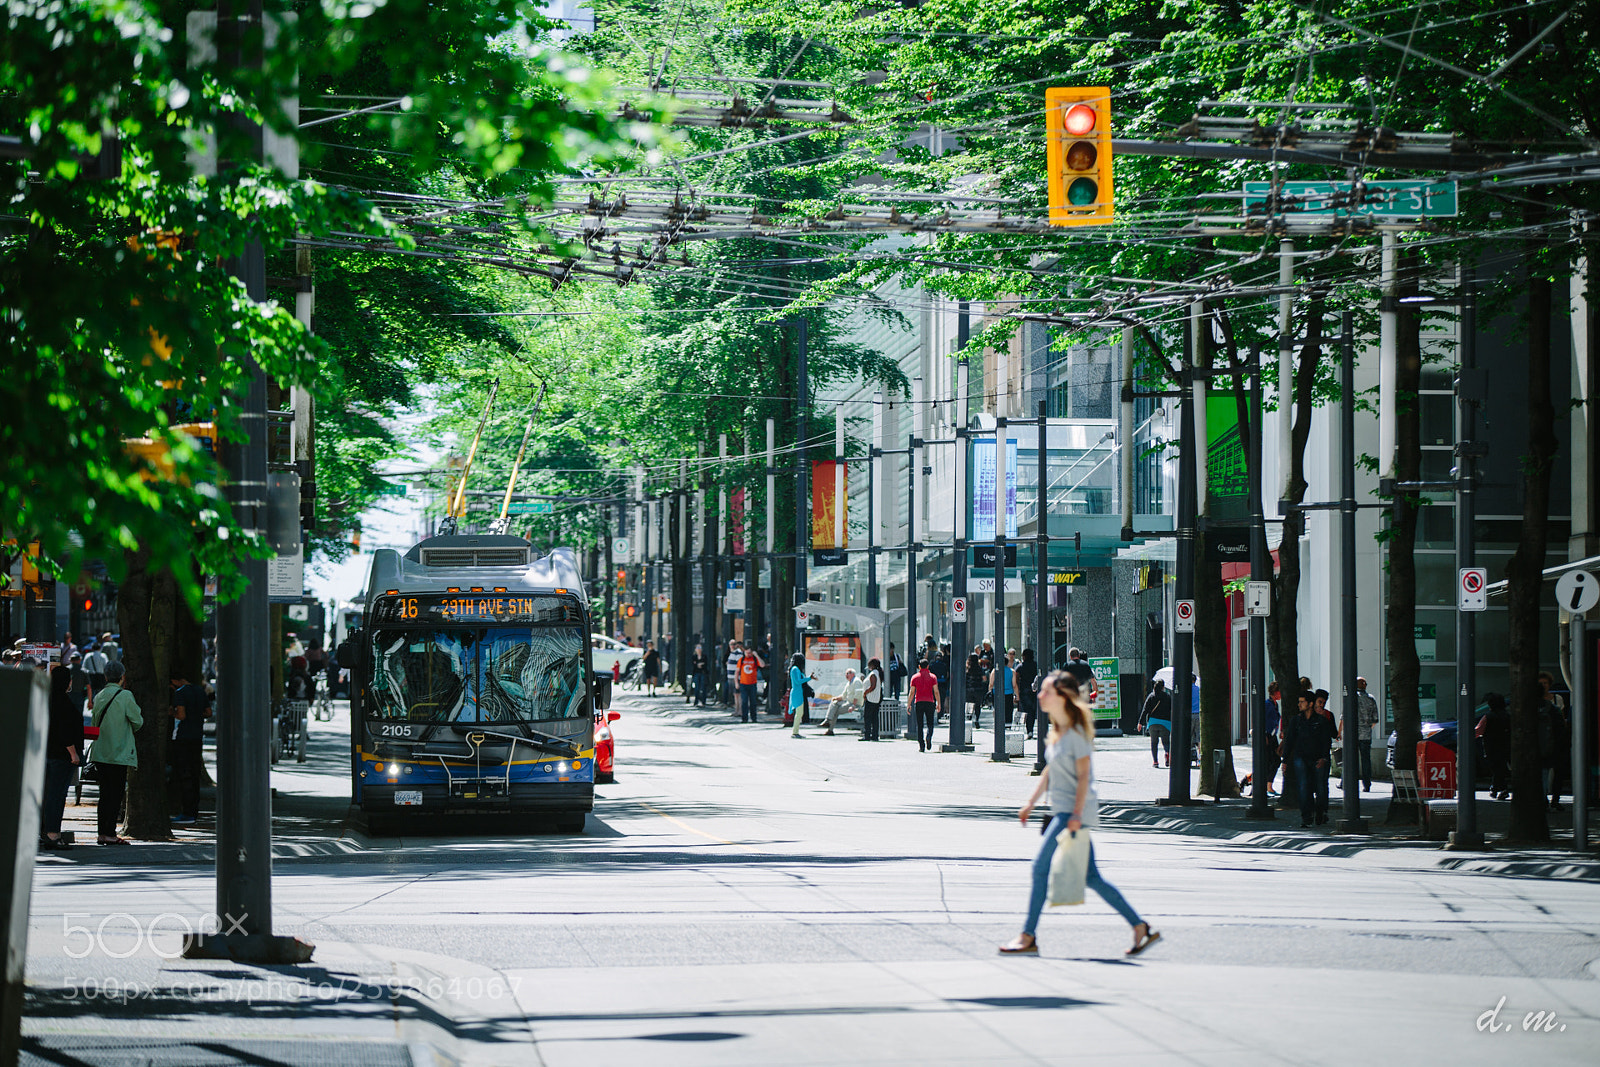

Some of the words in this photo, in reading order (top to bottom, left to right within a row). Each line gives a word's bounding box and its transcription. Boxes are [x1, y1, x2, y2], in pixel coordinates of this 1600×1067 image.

[1410, 186, 1433, 210] St
[979, 579, 1010, 591] SMK
[1031, 573, 1081, 584] SBWAY
[400, 598, 418, 618] 16
[441, 599, 474, 615] 29TH
[478, 598, 504, 615] AVE
[508, 598, 533, 614] STN
[381, 725, 412, 737] 2105
[1430, 766, 1447, 781] 24
